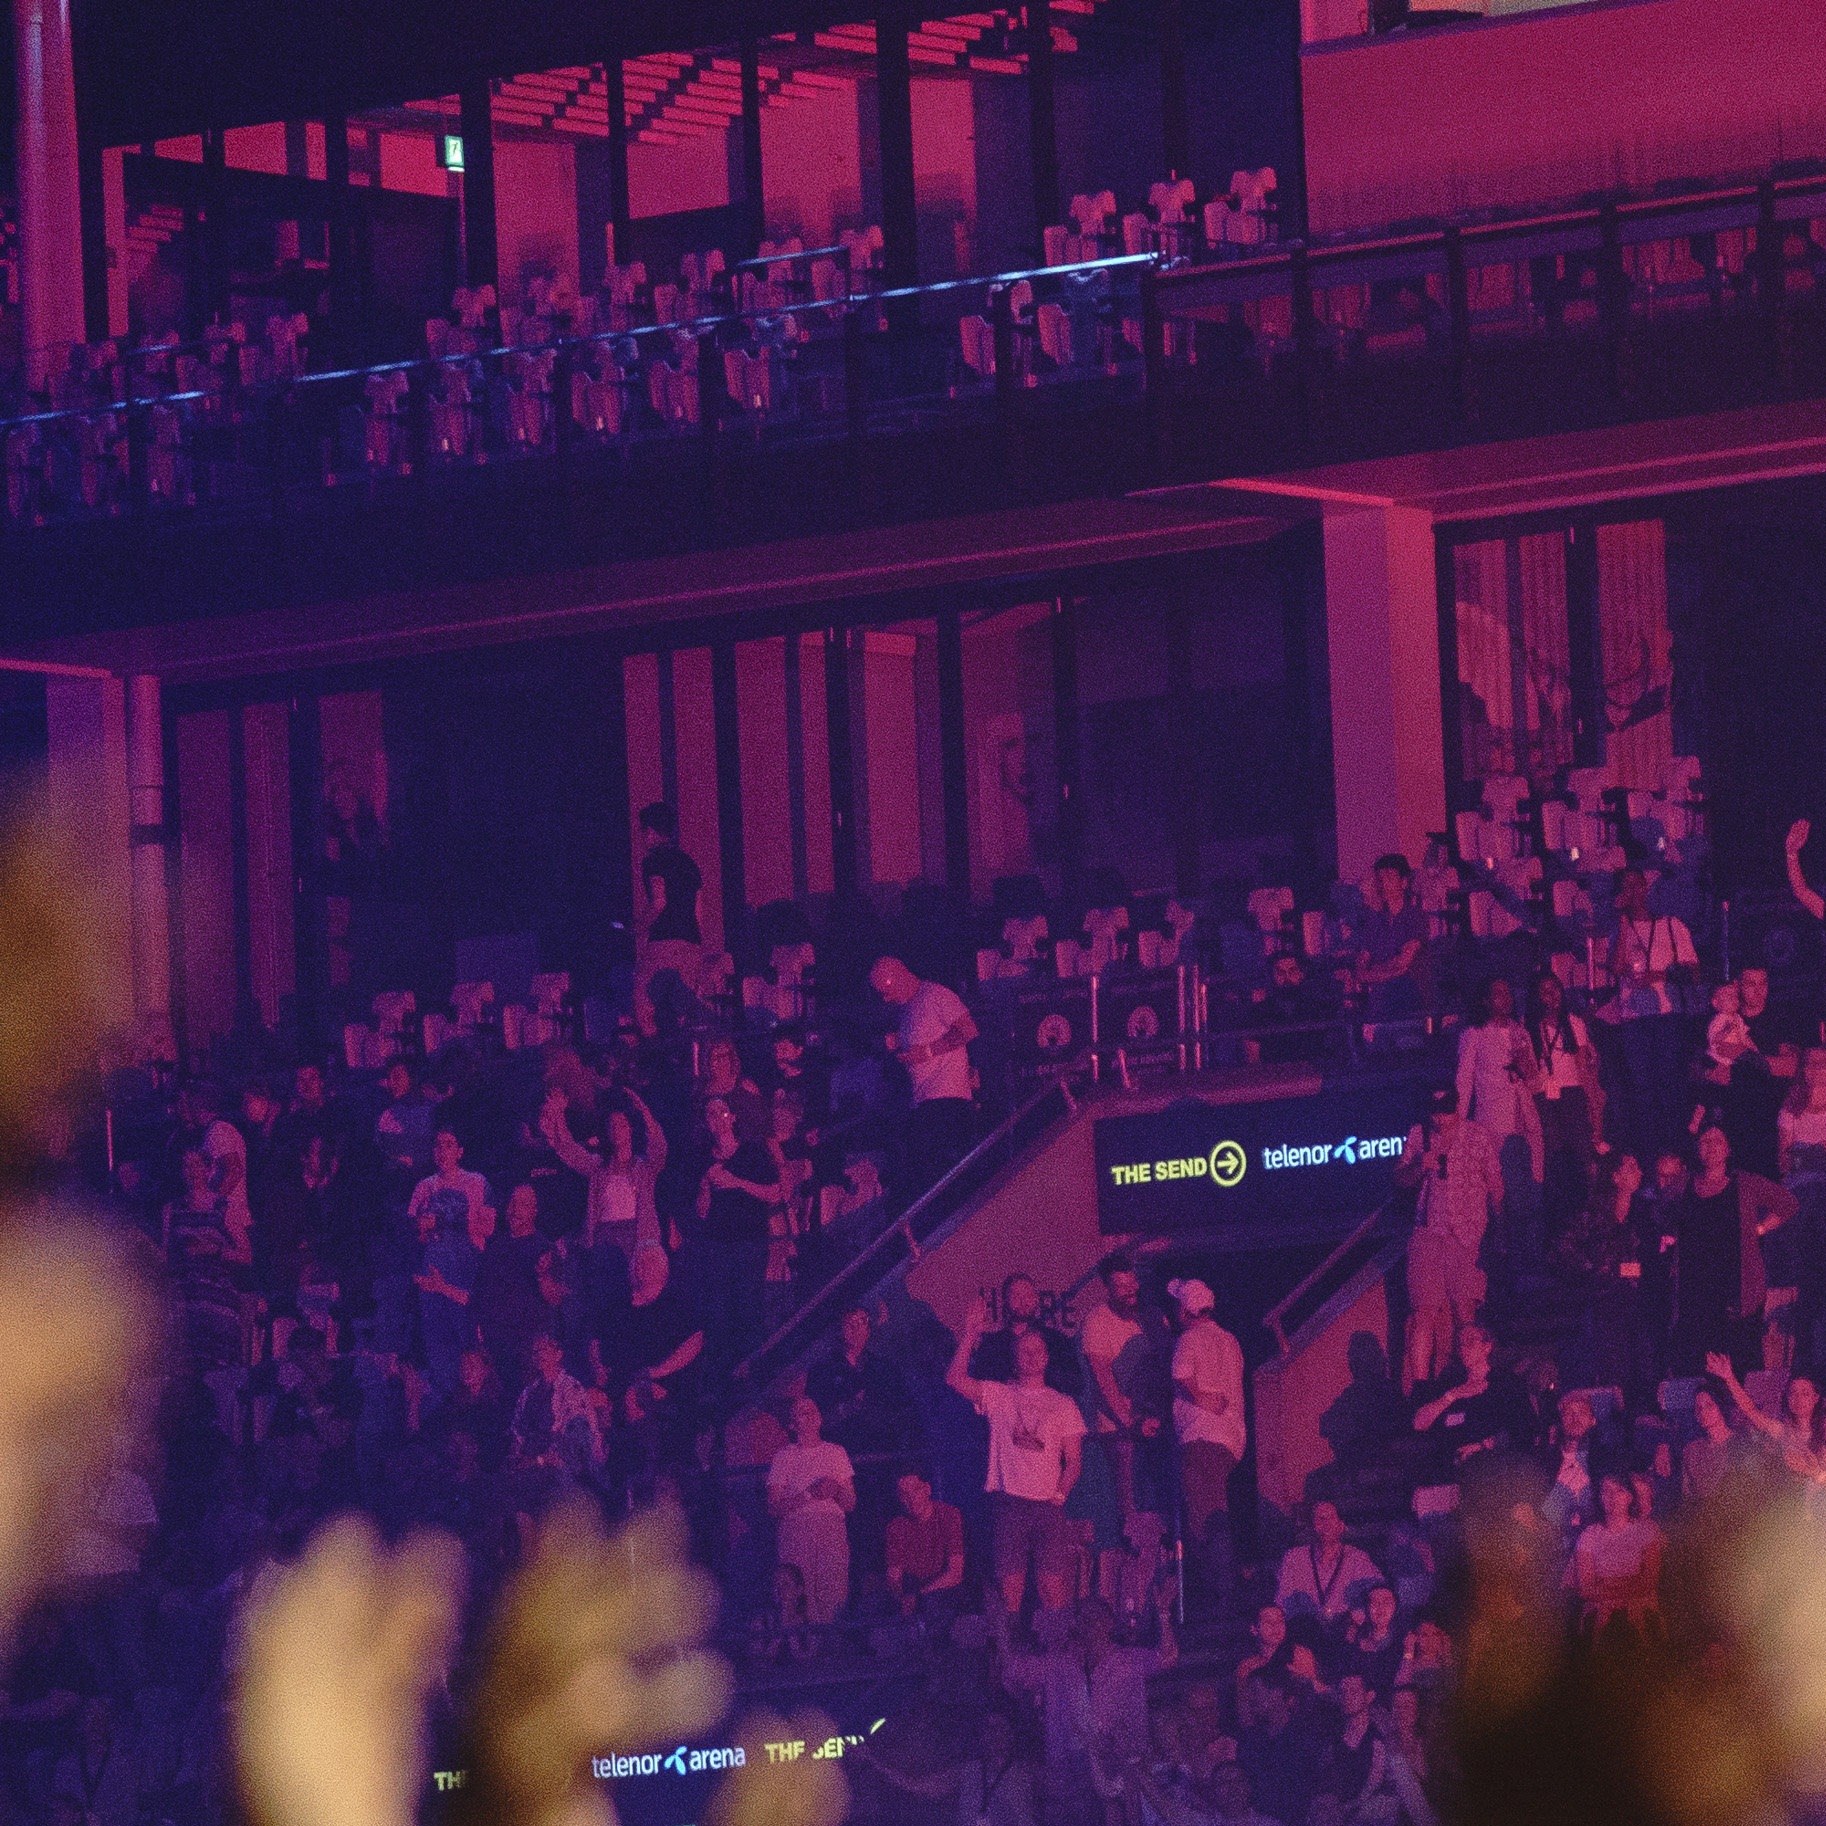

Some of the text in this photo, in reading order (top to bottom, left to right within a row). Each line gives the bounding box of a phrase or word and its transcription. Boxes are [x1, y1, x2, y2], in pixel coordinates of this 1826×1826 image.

[1262, 1136, 1407, 1170] telenor aren
[1110, 1157, 1207, 1185] THE SEND
[591, 1747, 745, 1778] telenor arena
